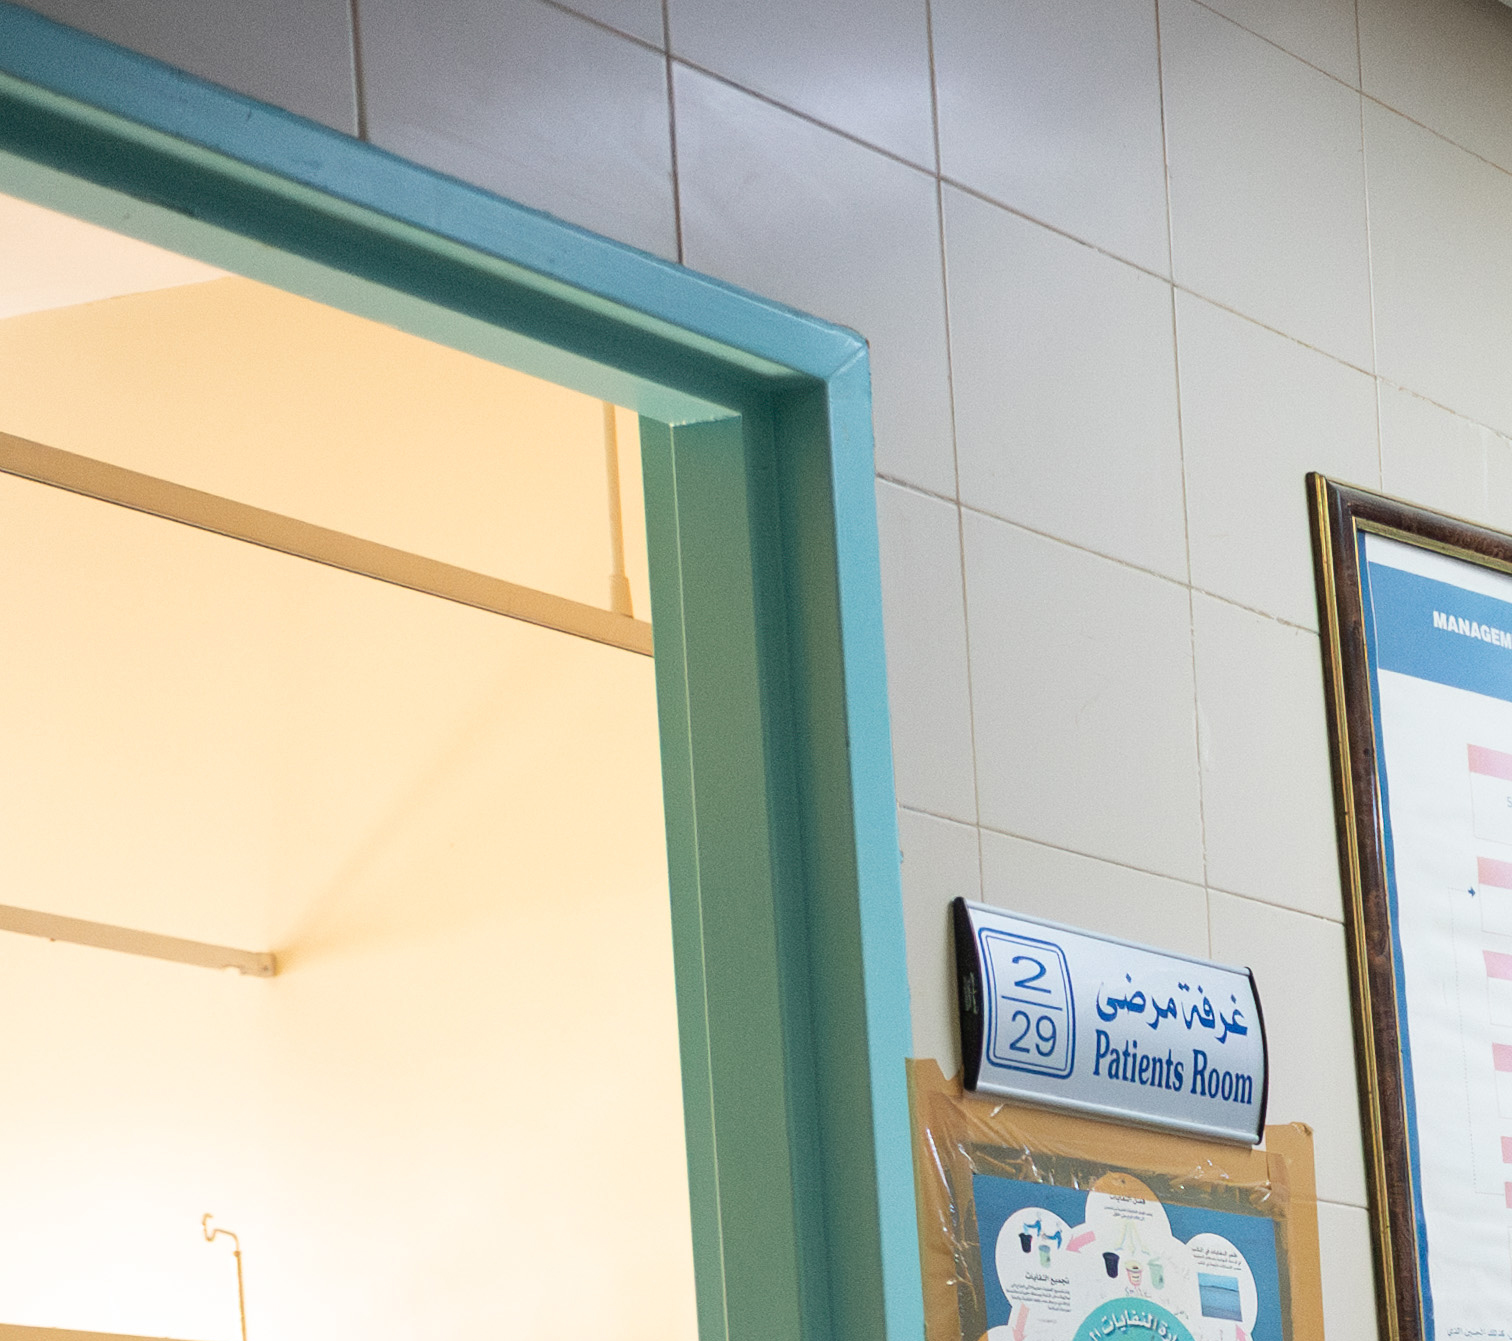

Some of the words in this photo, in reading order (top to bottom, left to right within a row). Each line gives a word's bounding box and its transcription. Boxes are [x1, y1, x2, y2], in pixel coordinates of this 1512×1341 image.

[1010, 955, 1052, 994] 2
[1096, 972, 1178, 1031] مرضى
[1178, 981, 1249, 1045] غرفة
[1008, 1009, 1057, 1058] 29
[1092, 1028, 1185, 1093] Patients
[1189, 1048, 1253, 1106] Room
[1025, 1271, 1050, 1284] النفايات
[1050, 1275, 1070, 1287] تجميع
[1100, 1309, 1158, 1336] النفايات
